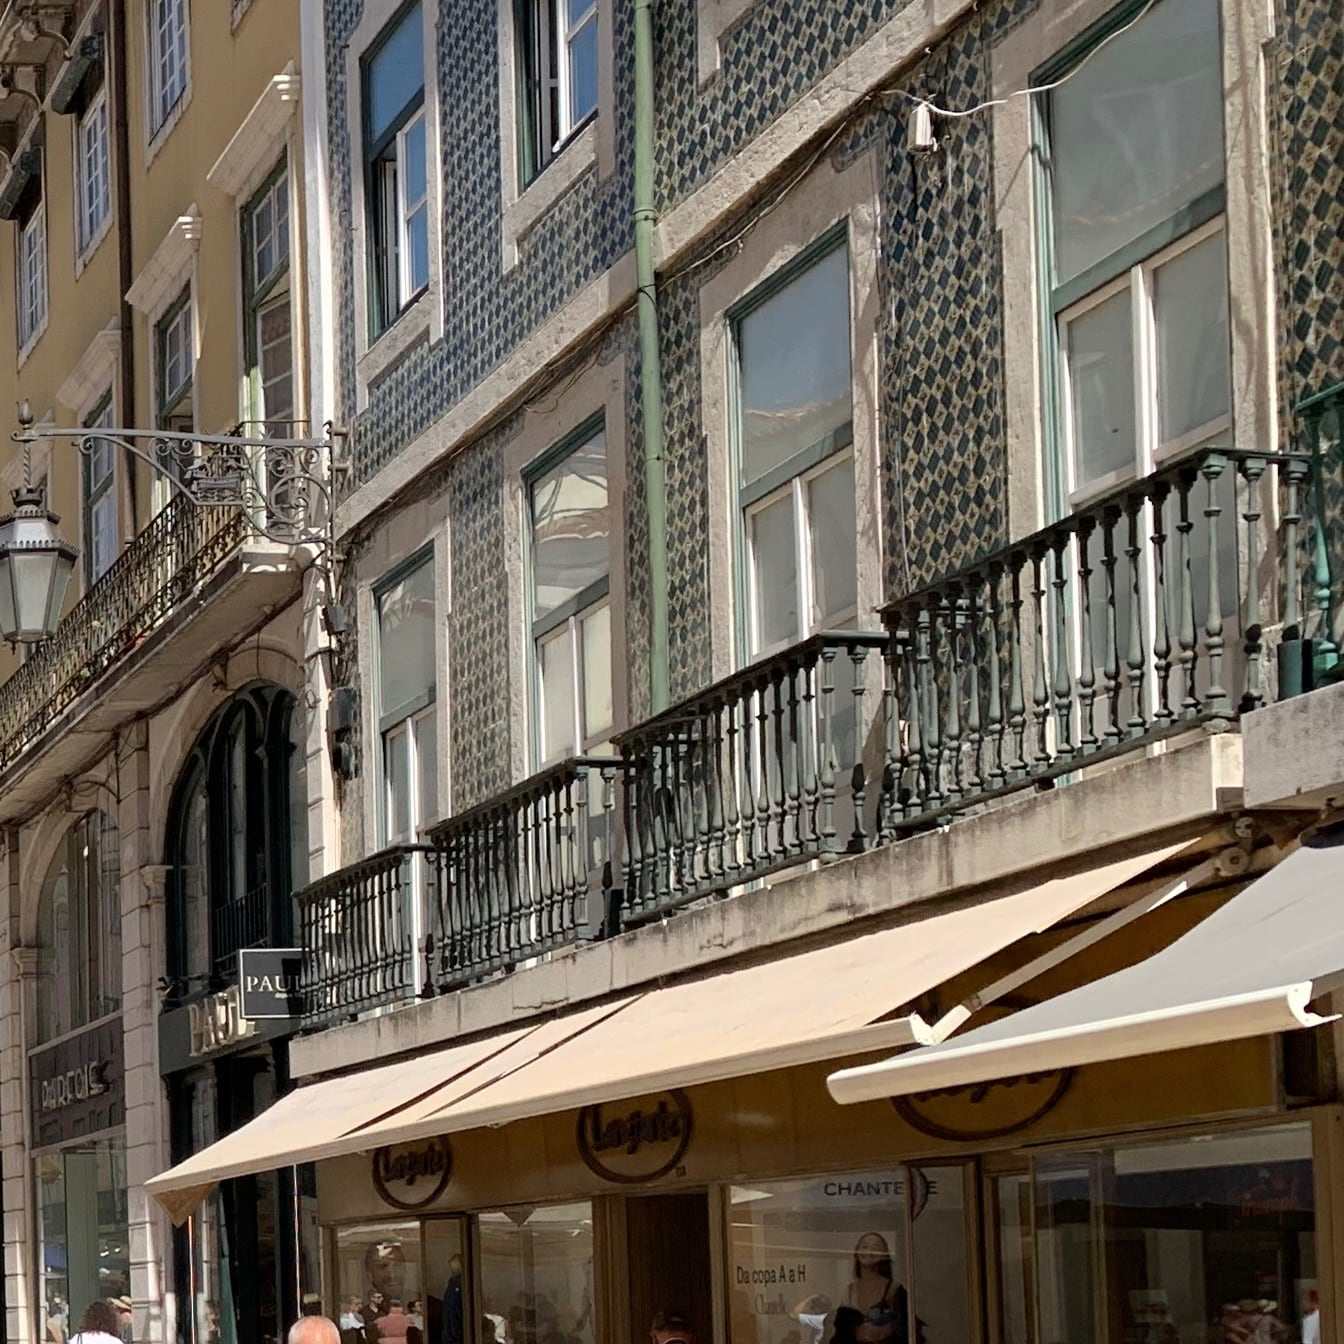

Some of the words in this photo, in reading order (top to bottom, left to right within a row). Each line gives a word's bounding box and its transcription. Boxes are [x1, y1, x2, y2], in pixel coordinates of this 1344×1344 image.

[823, 1180, 938, 1197] CHANTEE
[736, 1266, 750, 1284] Da
[751, 1269, 777, 1287] copa
[778, 1264, 787, 1283] A
[788, 1268, 796, 1283] a
[797, 1263, 806, 1283] H
